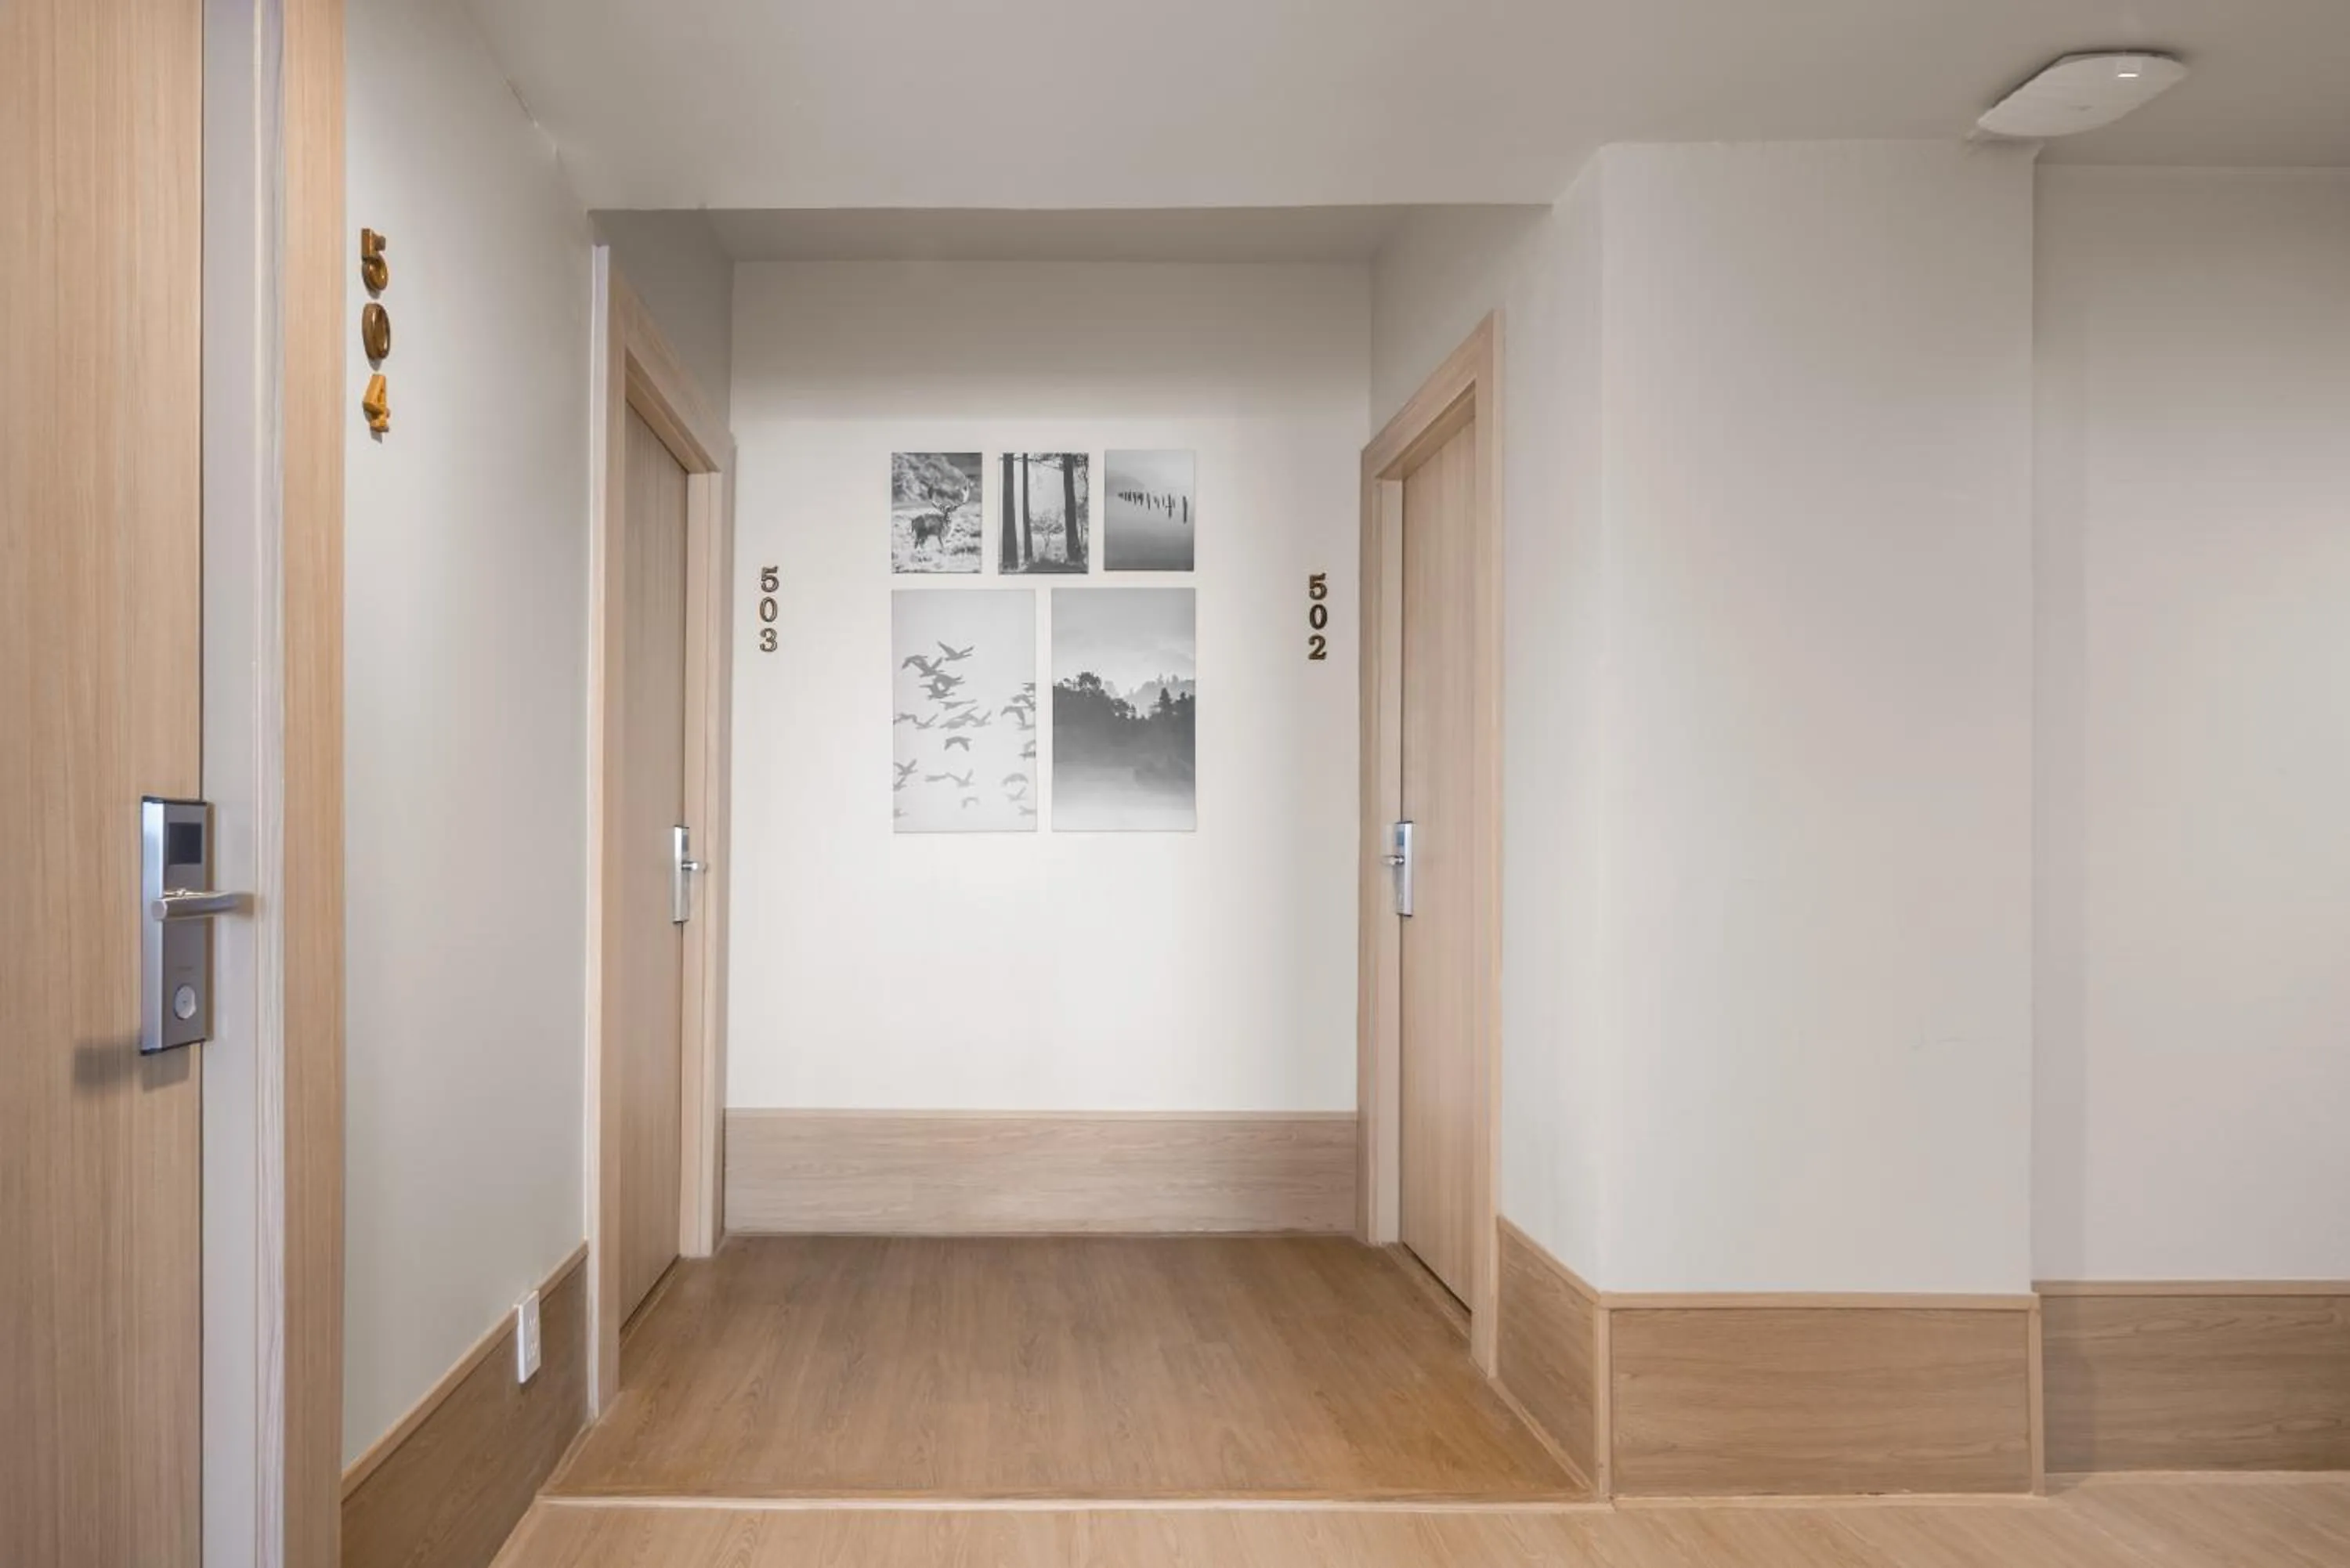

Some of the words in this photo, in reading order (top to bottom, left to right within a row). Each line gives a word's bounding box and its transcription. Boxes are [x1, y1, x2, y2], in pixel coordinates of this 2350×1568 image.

[361, 228, 390, 432] 504
[759, 565, 779, 652] 503
[1308, 573, 1328, 660] 502
